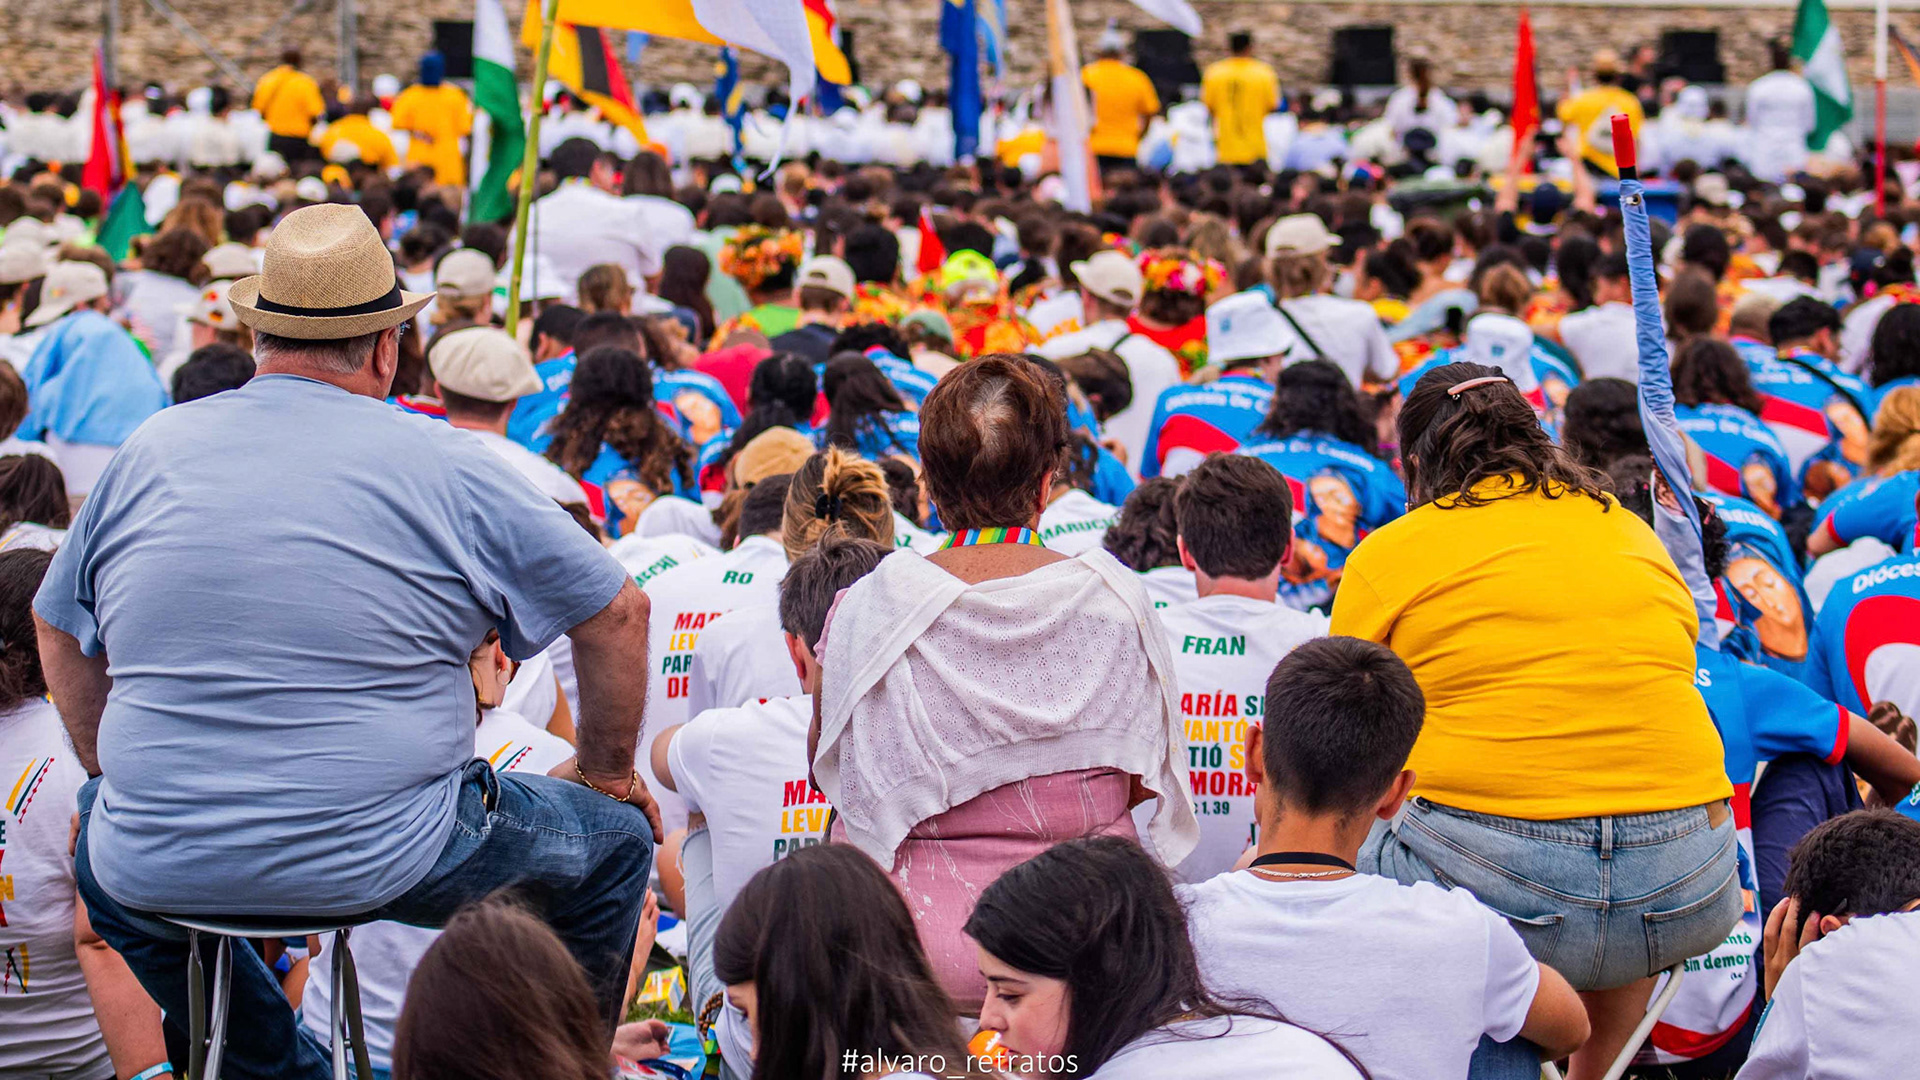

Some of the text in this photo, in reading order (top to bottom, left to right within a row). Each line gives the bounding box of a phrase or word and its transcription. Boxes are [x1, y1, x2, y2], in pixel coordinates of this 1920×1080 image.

[722, 571, 753, 585] RO
[1182, 635, 1246, 655] FRAN
[1213, 801, 1230, 815] 39
